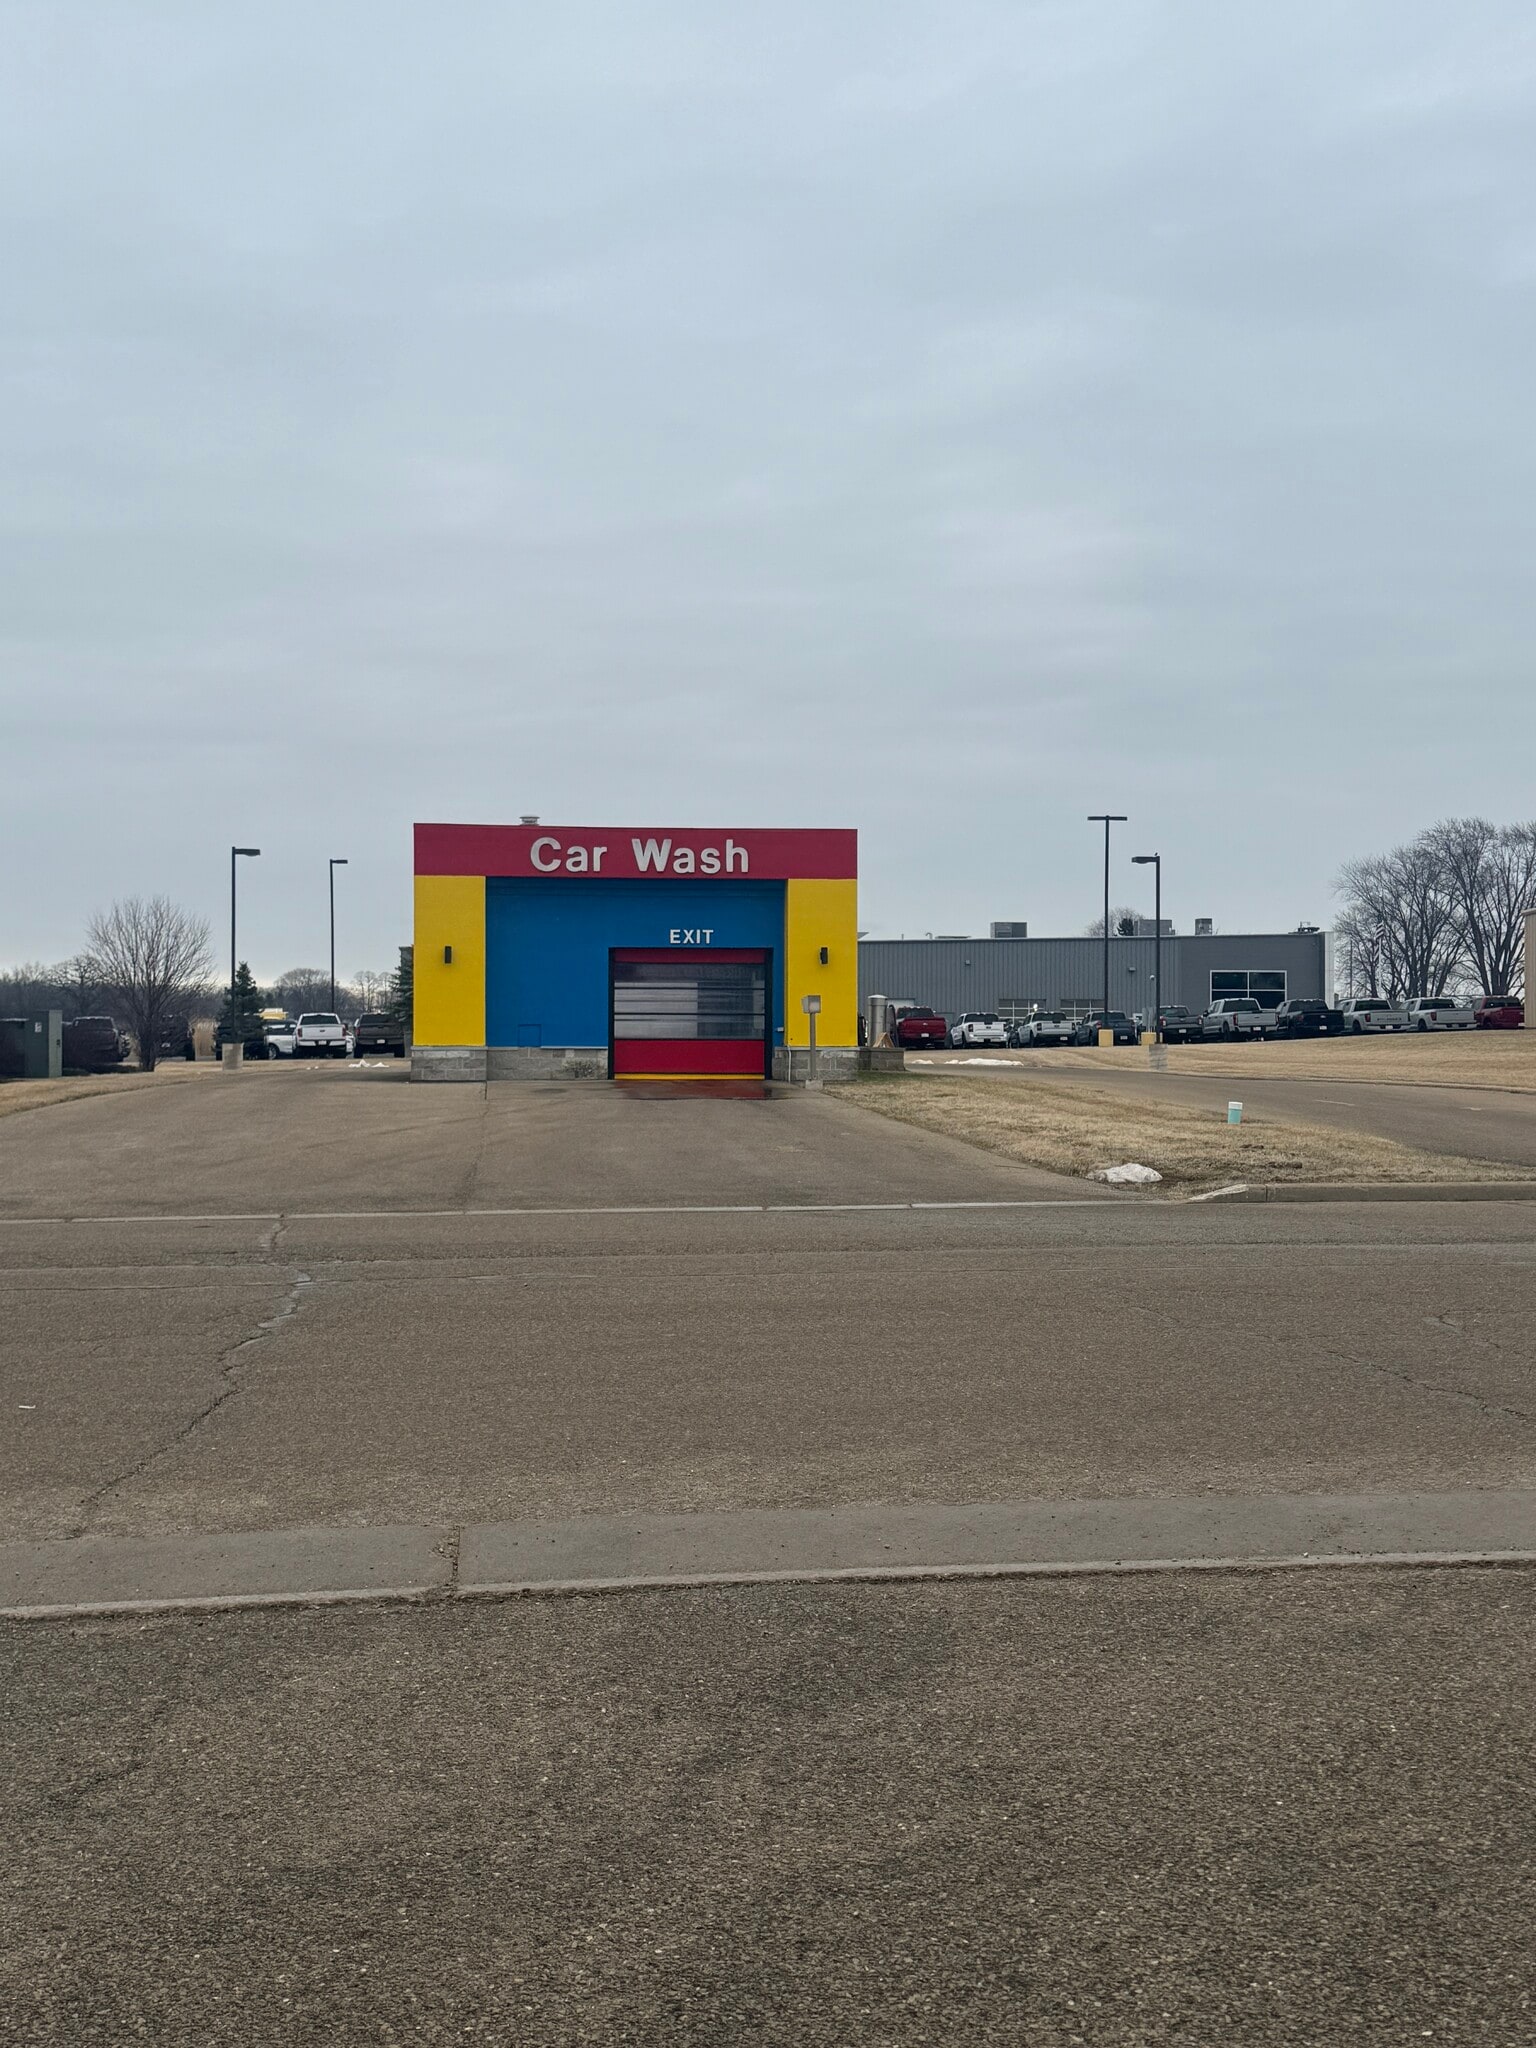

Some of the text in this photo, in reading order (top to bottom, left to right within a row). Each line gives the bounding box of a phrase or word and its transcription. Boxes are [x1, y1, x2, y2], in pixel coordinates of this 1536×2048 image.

[530, 837, 749, 874] Car Wash
[670, 929, 714, 944] EXIT
